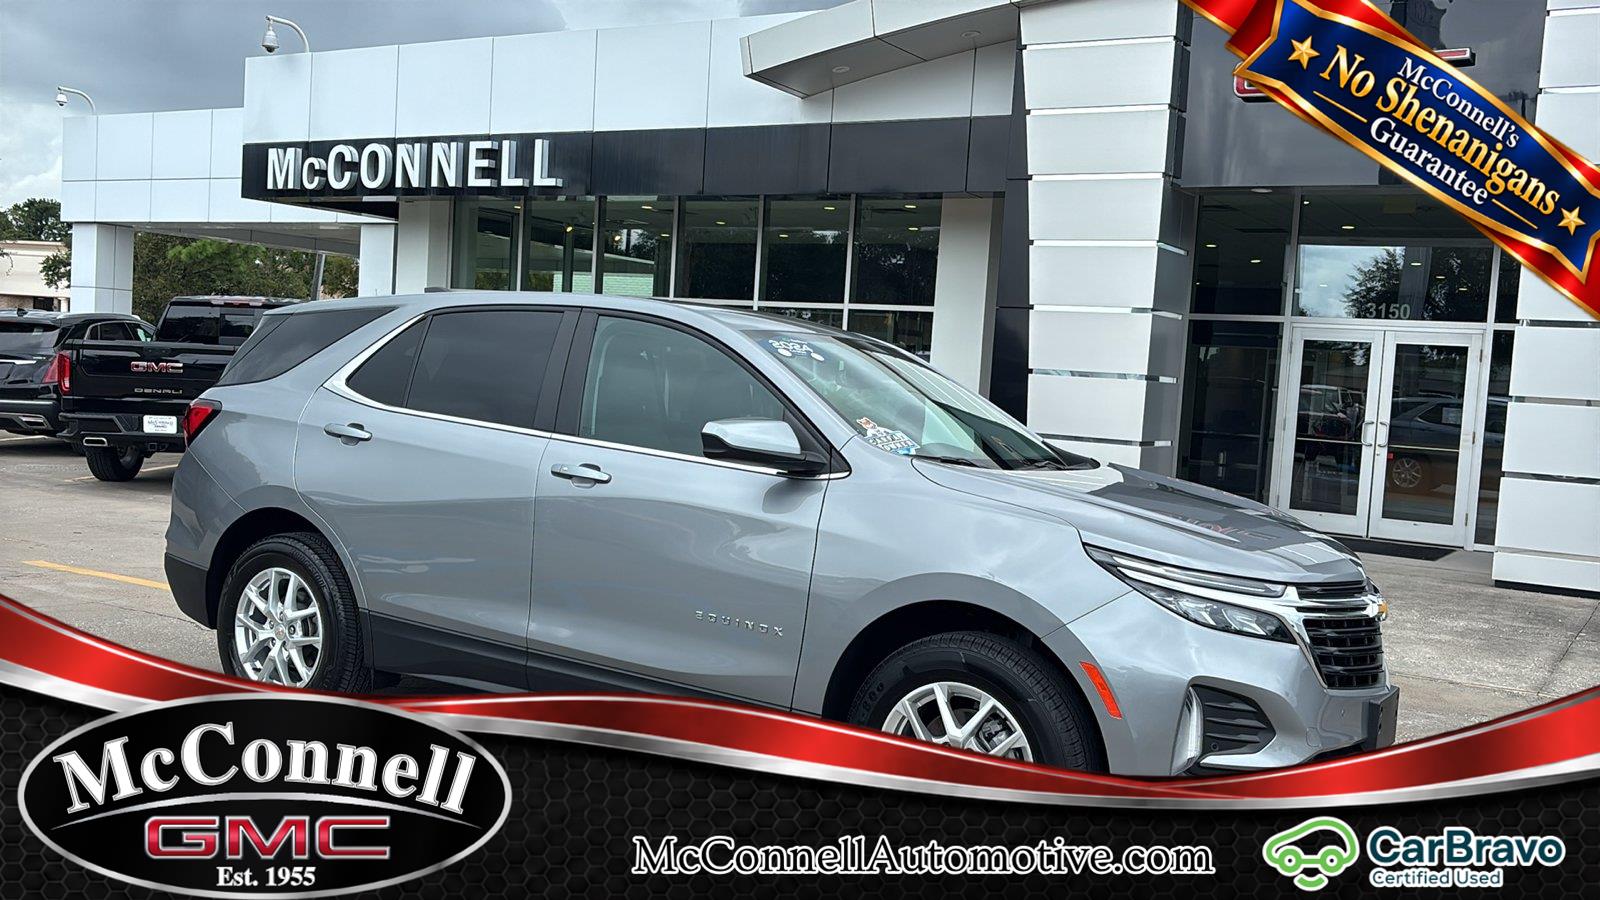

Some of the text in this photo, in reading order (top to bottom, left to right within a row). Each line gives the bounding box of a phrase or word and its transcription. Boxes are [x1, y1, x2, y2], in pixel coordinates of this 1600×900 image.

[1366, 303, 1411, 320] 3150
[130, 361, 184, 374] GMC
[134, 387, 183, 395] DENALI
[695, 610, 783, 637] EQUINOX
